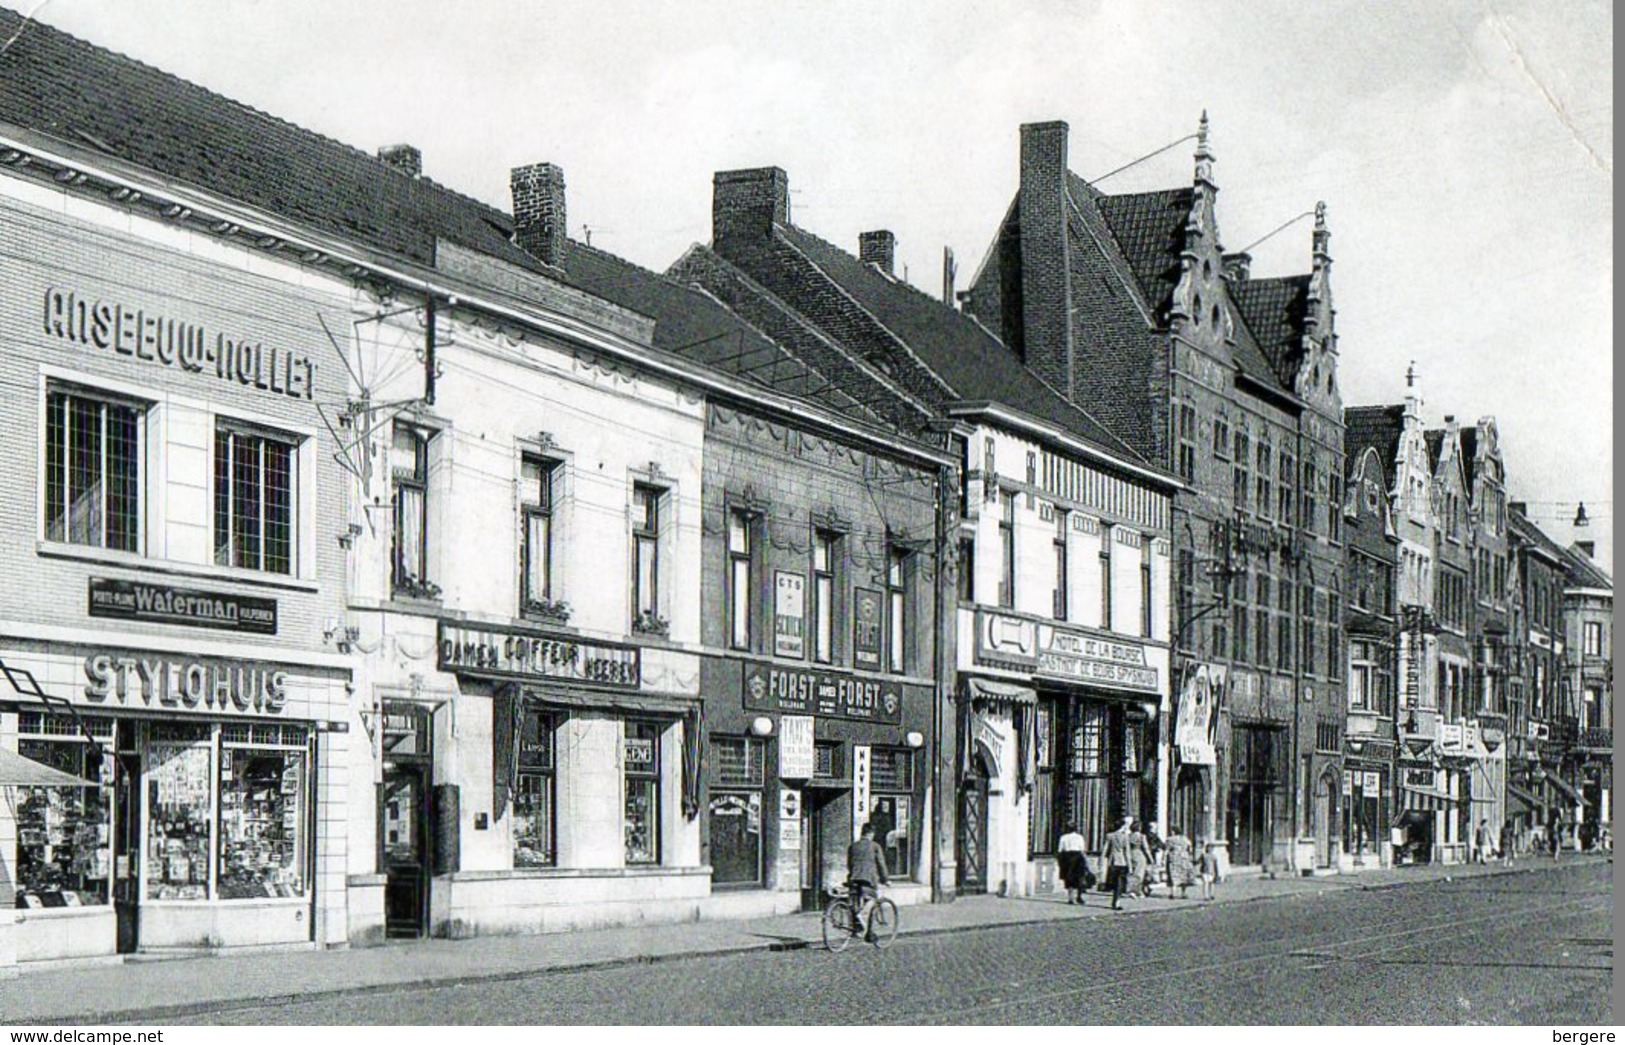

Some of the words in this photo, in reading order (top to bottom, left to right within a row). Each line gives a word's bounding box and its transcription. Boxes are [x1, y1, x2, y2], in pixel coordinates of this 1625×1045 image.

[44, 286, 317, 400] ANSEEUW-NOLLET
[134, 586, 239, 620] Waterman
[443, 638, 498, 668] DAMEN
[505, 636, 579, 667] COIFFEUR
[1055, 635, 1082, 653] HOTEL
[1085, 640, 1096, 655] DE
[1099, 642, 1109, 657] LA
[1112, 645, 1141, 663] BOURSE
[84, 655, 288, 714] STYLOHUIS
[769, 669, 816, 701] FORST
[1093, 663, 1115, 680] BEURS
[838, 679, 880, 711] FORST
